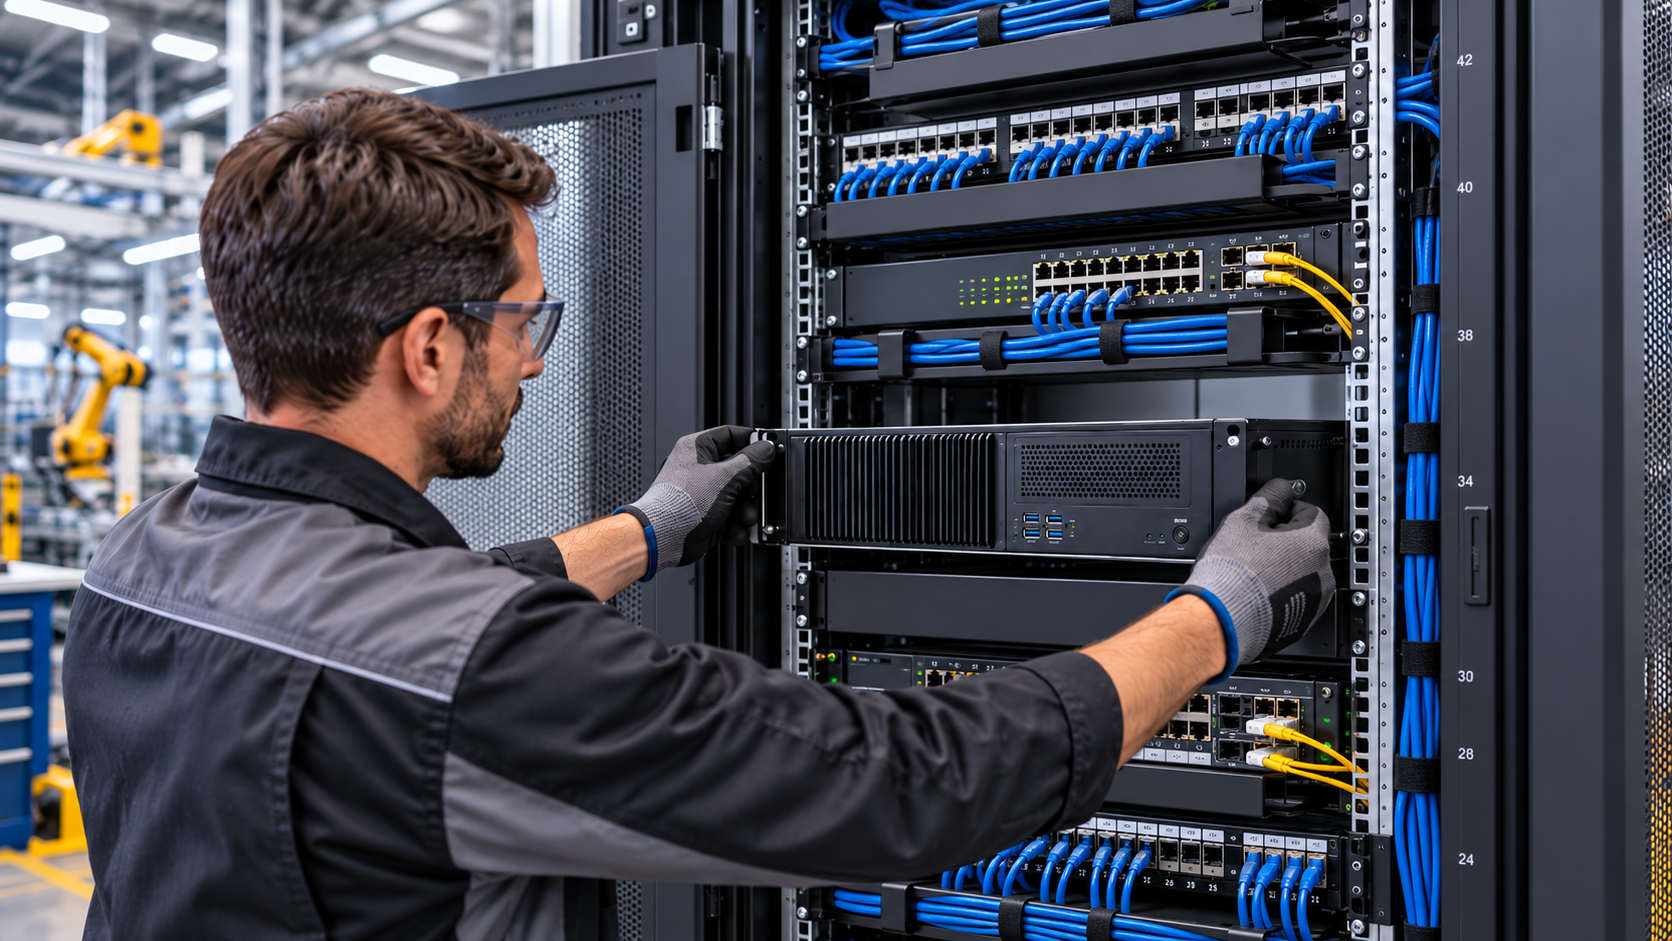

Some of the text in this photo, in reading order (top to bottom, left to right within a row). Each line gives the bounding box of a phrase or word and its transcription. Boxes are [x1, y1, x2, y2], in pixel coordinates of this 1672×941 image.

[1457, 54, 1473, 66] 42
[1457, 181, 1473, 194] 40
[1458, 329, 1474, 342] 38
[1457, 475, 1473, 488] 34
[1458, 669, 1474, 682] 30
[1458, 747, 1474, 760] 28
[1458, 853, 1475, 865] 24
